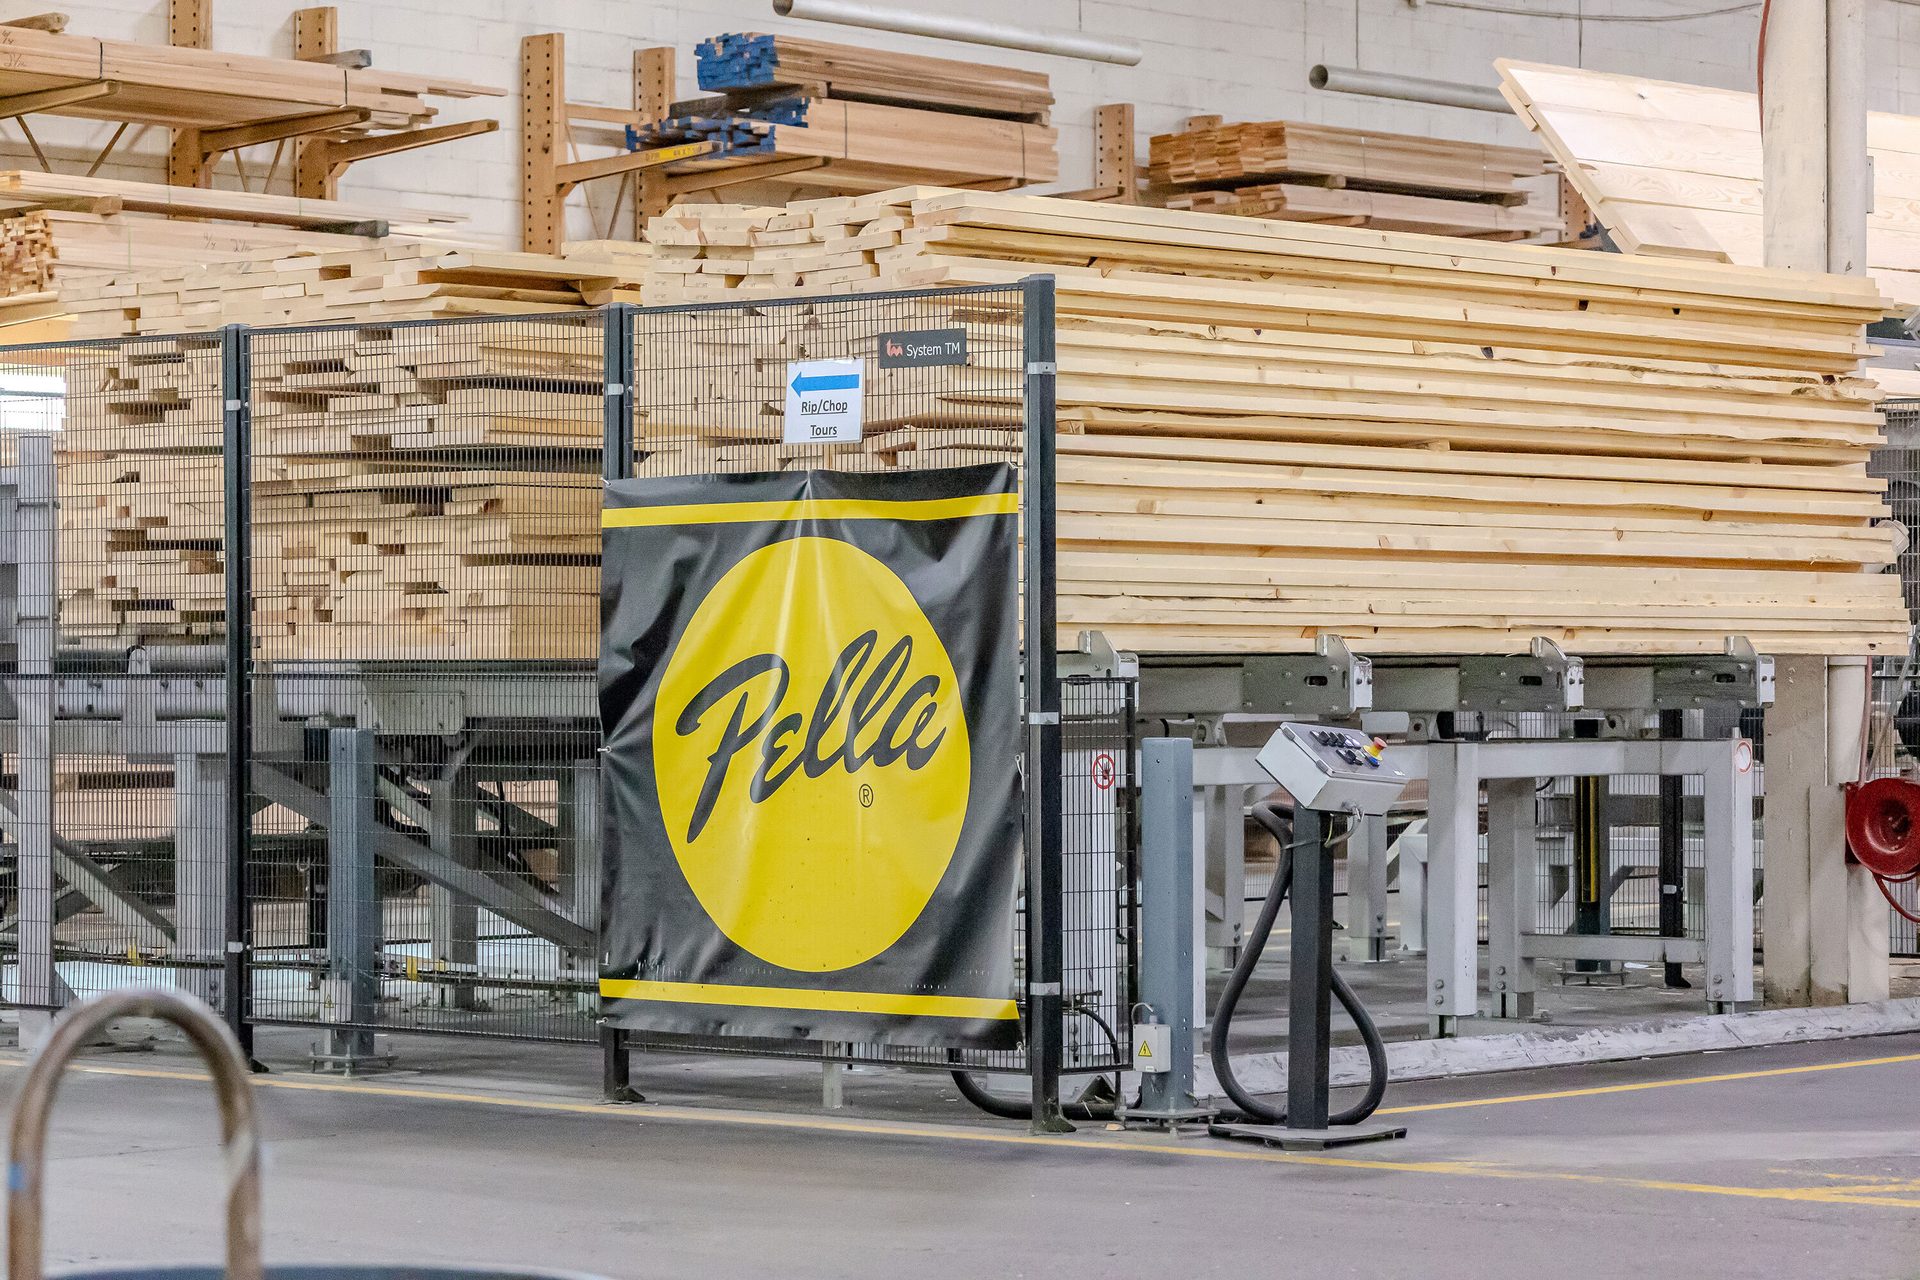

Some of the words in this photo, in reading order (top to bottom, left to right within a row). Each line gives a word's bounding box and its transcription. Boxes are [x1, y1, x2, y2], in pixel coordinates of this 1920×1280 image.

[906, 344, 942, 359] System
[944, 341, 960, 355] TM
[801, 399, 848, 414] Rip/Chop
[810, 424, 838, 437] Tours
[675, 629, 947, 844] Pella
